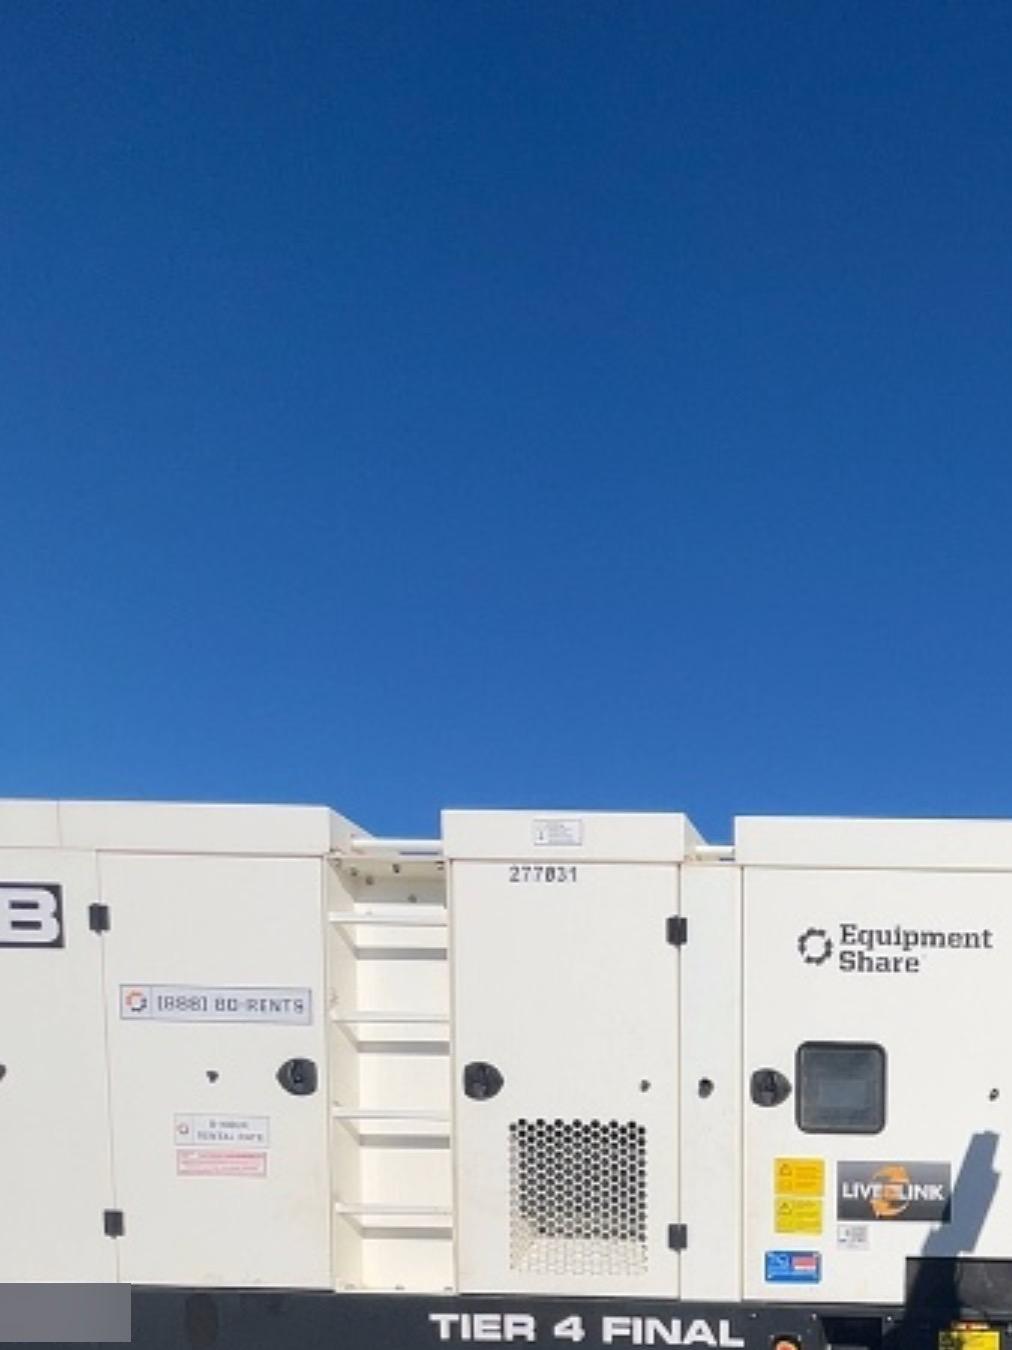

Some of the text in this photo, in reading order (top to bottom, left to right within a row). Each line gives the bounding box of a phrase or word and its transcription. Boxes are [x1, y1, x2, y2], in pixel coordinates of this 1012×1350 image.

[509, 866, 577, 883] 277031
[839, 923, 994, 951] Equipment
[839, 950, 920, 973] Share
[429, 1313, 746, 1346] TIER 4 FINAL
